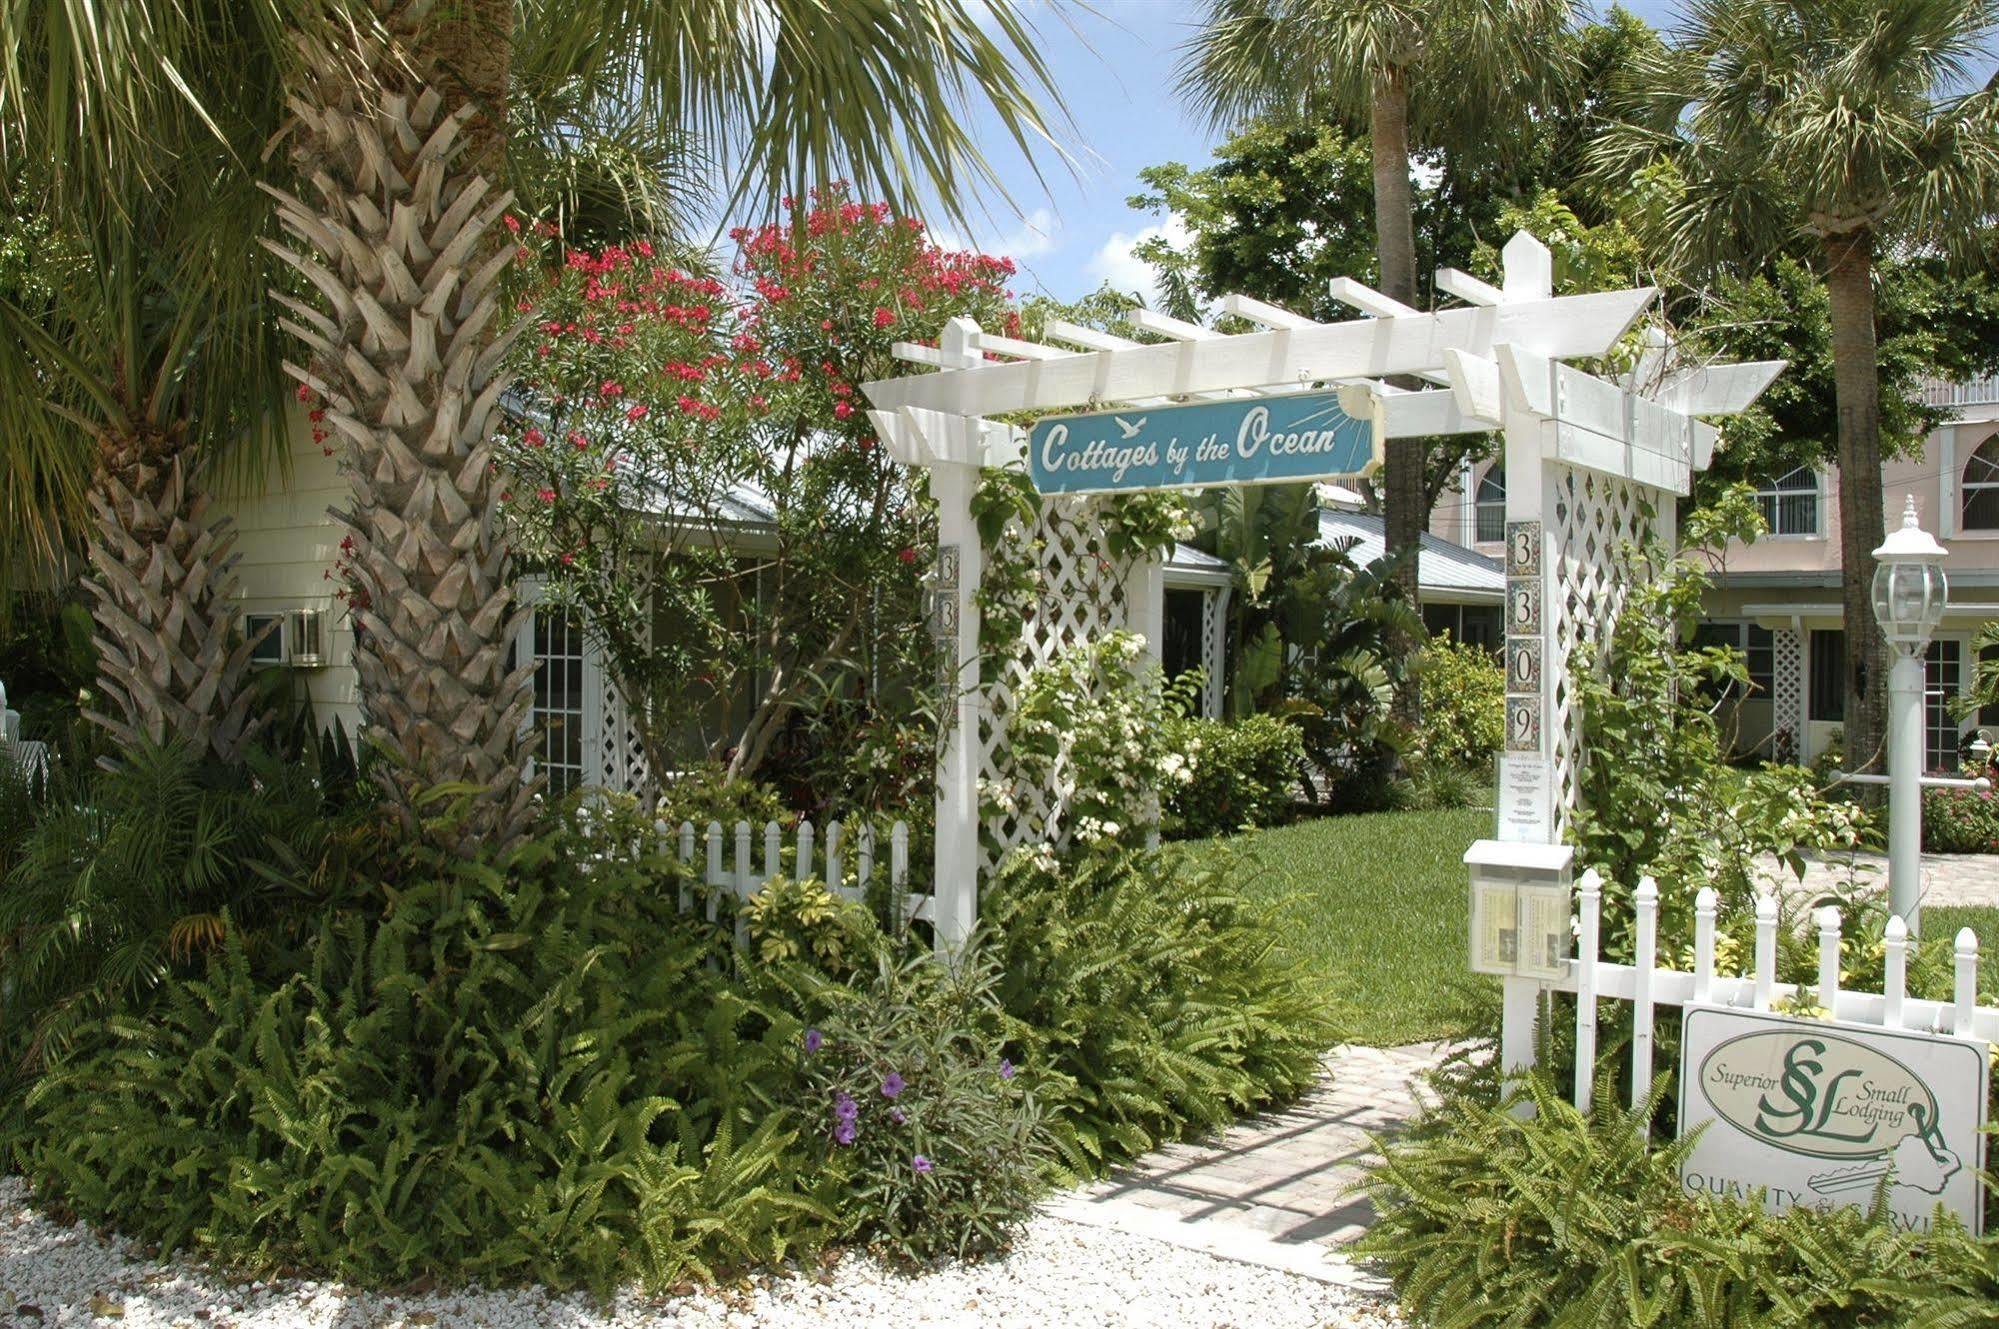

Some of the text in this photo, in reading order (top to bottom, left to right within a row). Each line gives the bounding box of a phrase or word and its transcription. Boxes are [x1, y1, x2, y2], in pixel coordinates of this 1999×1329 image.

[1041, 405, 1336, 483] Cottages by the Ocean
[1515, 532, 1533, 740] 3309
[1710, 1063, 1779, 1091] Superior
[1856, 1080, 1911, 1105] Small
[1832, 1096, 1905, 1128] Lodging
